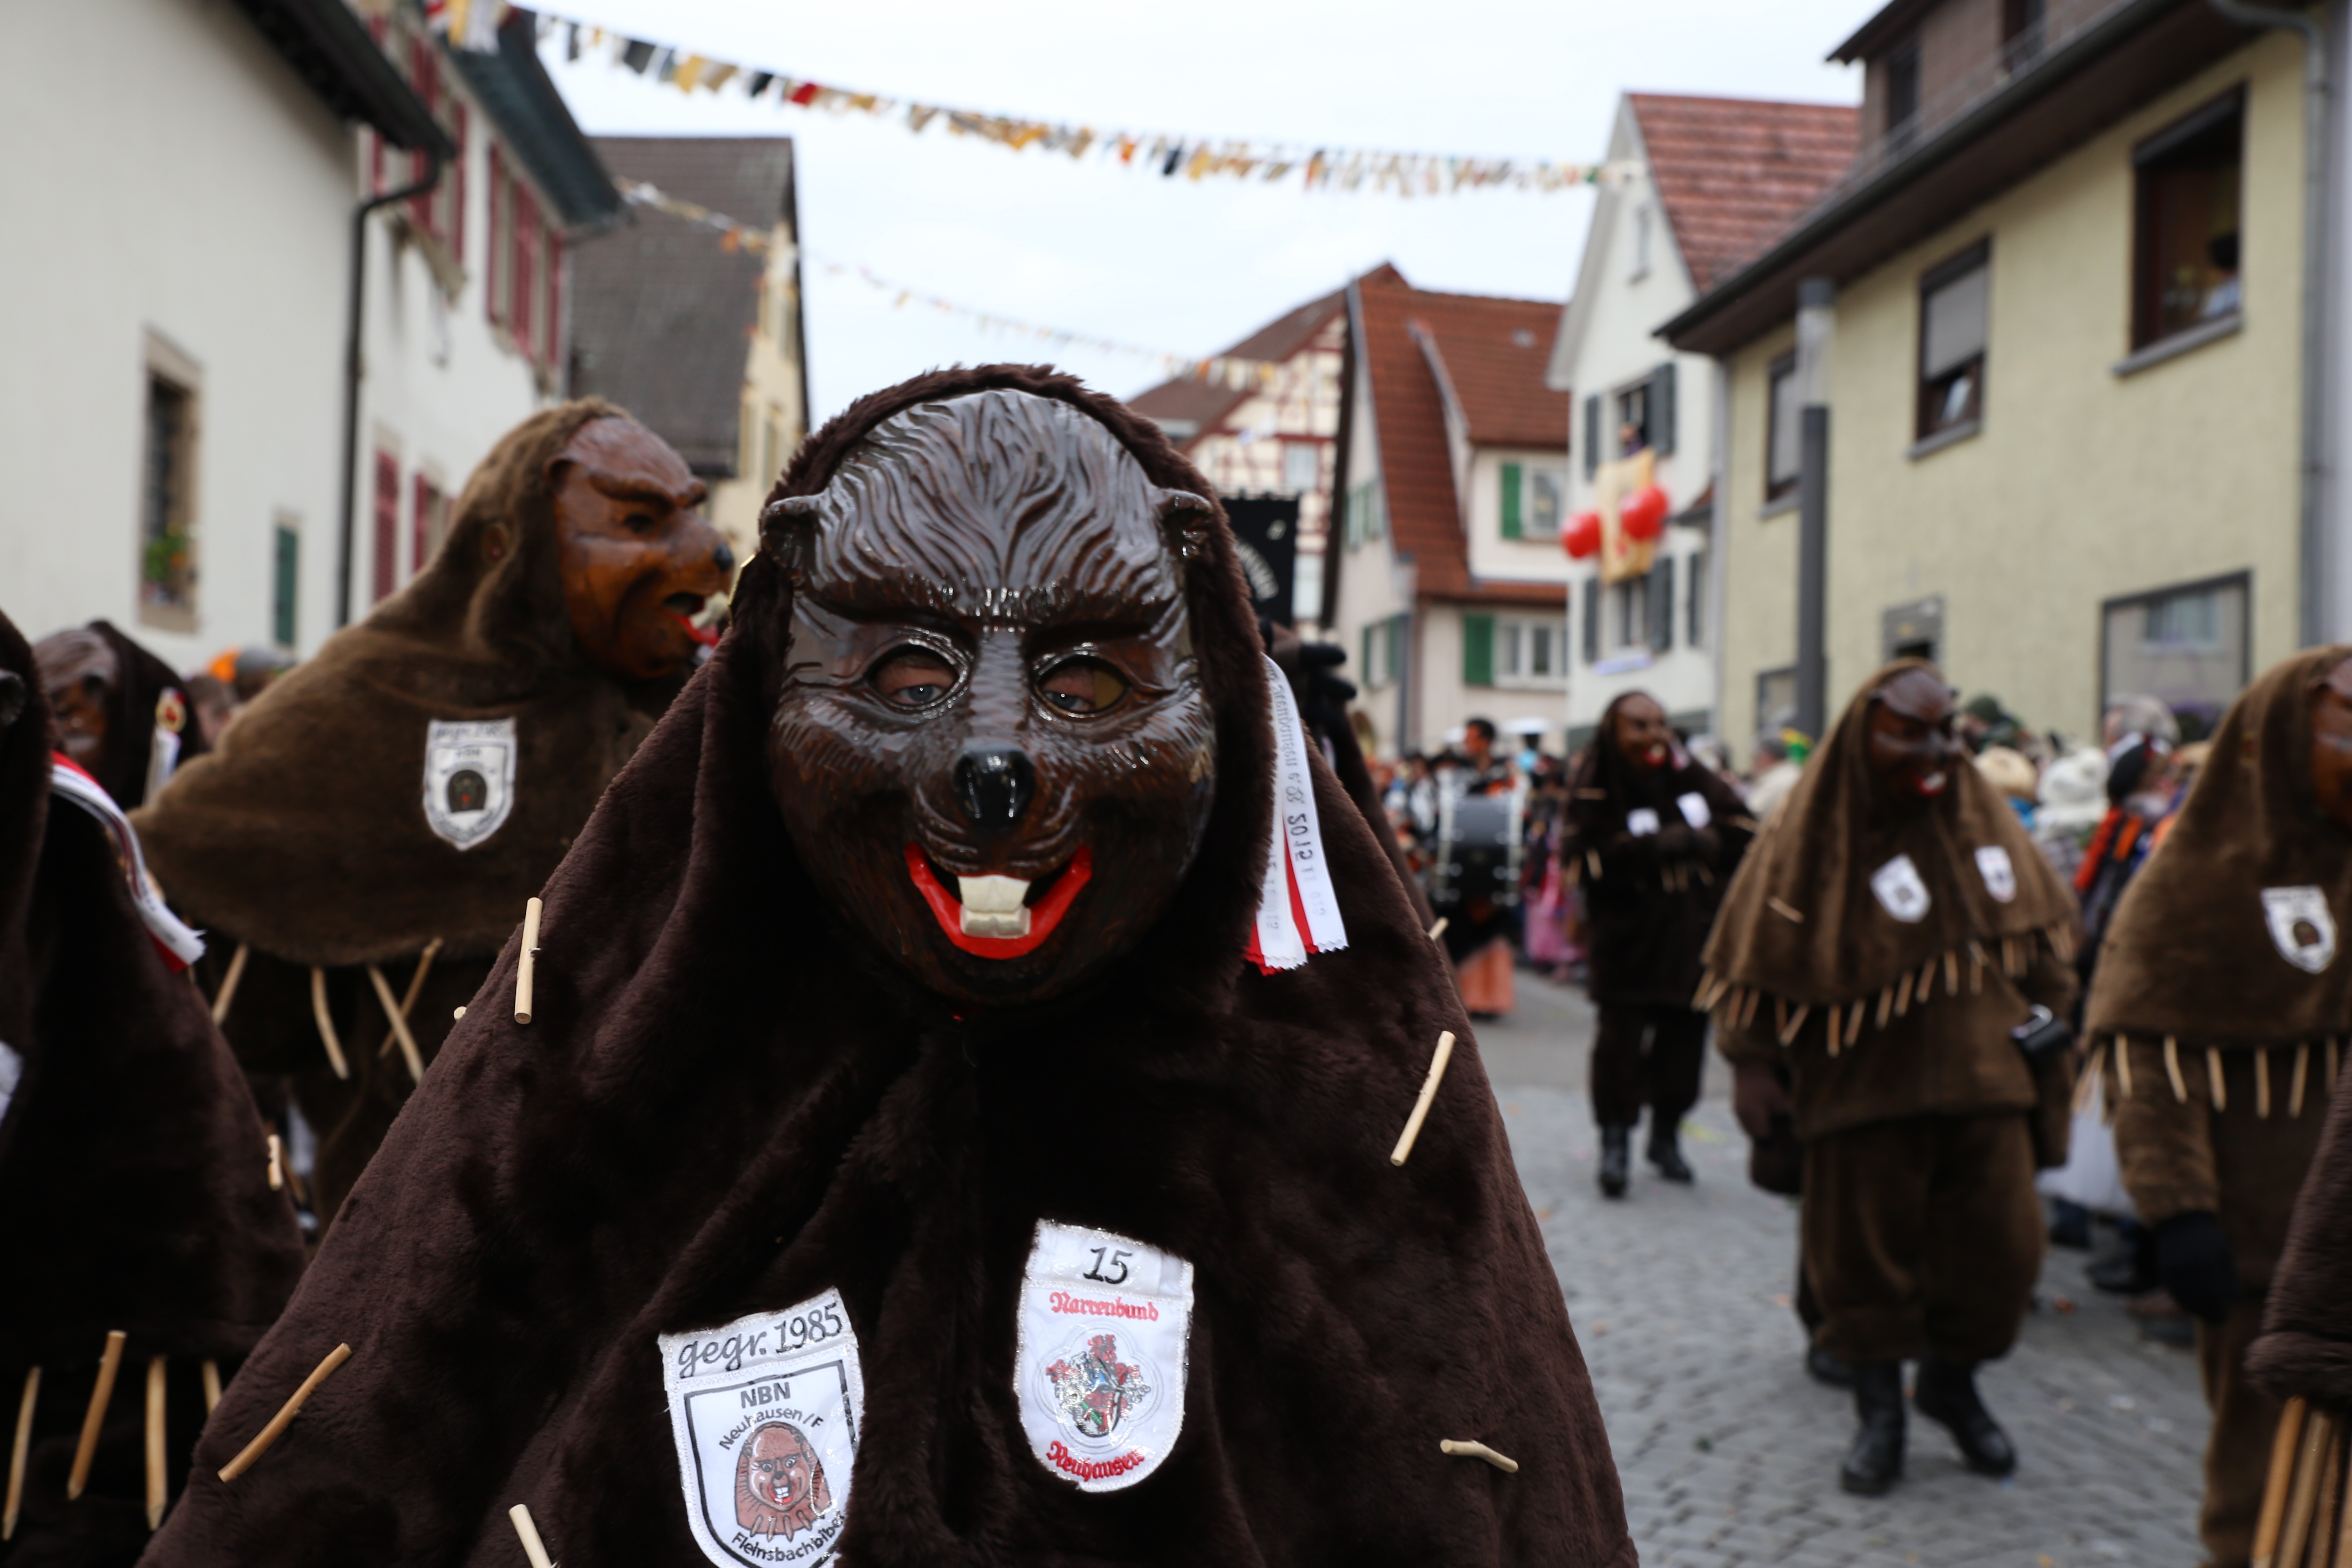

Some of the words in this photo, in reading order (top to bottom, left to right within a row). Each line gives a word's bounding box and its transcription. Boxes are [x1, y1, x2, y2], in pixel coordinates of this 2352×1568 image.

[1083, 1246, 1133, 1284] 15
[1049, 1291, 1158, 1322] Narrenbund
[678, 1331, 767, 1378] gegr.
[774, 1303, 843, 1354] 1985
[740, 1381, 791, 1409] NBN
[1046, 1440, 1145, 1482] Neuhausen
